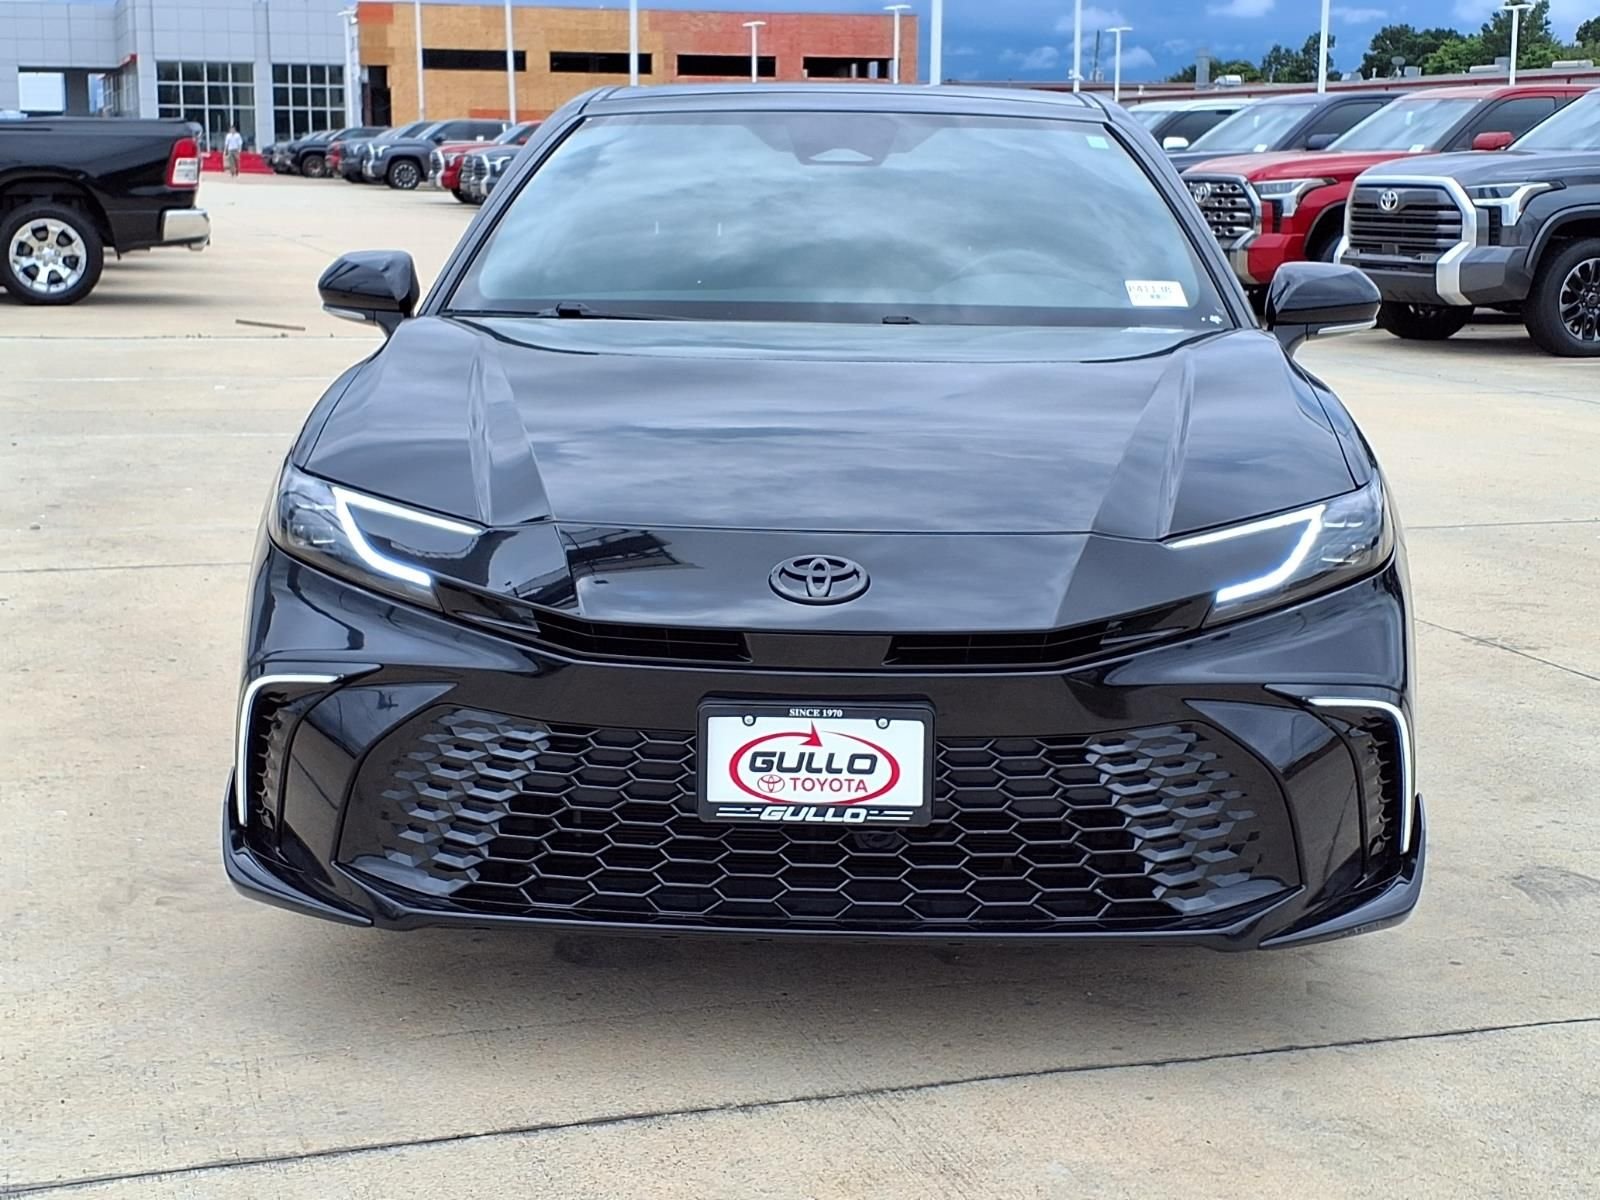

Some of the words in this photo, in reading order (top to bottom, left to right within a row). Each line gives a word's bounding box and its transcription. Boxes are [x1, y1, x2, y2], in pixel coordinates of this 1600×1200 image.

[789, 708, 820, 717] SINCE
[822, 709, 844, 718] 1970
[748, 751, 878, 775] GULLO
[789, 777, 868, 793] TOYOTA
[760, 806, 868, 823] GULLO
